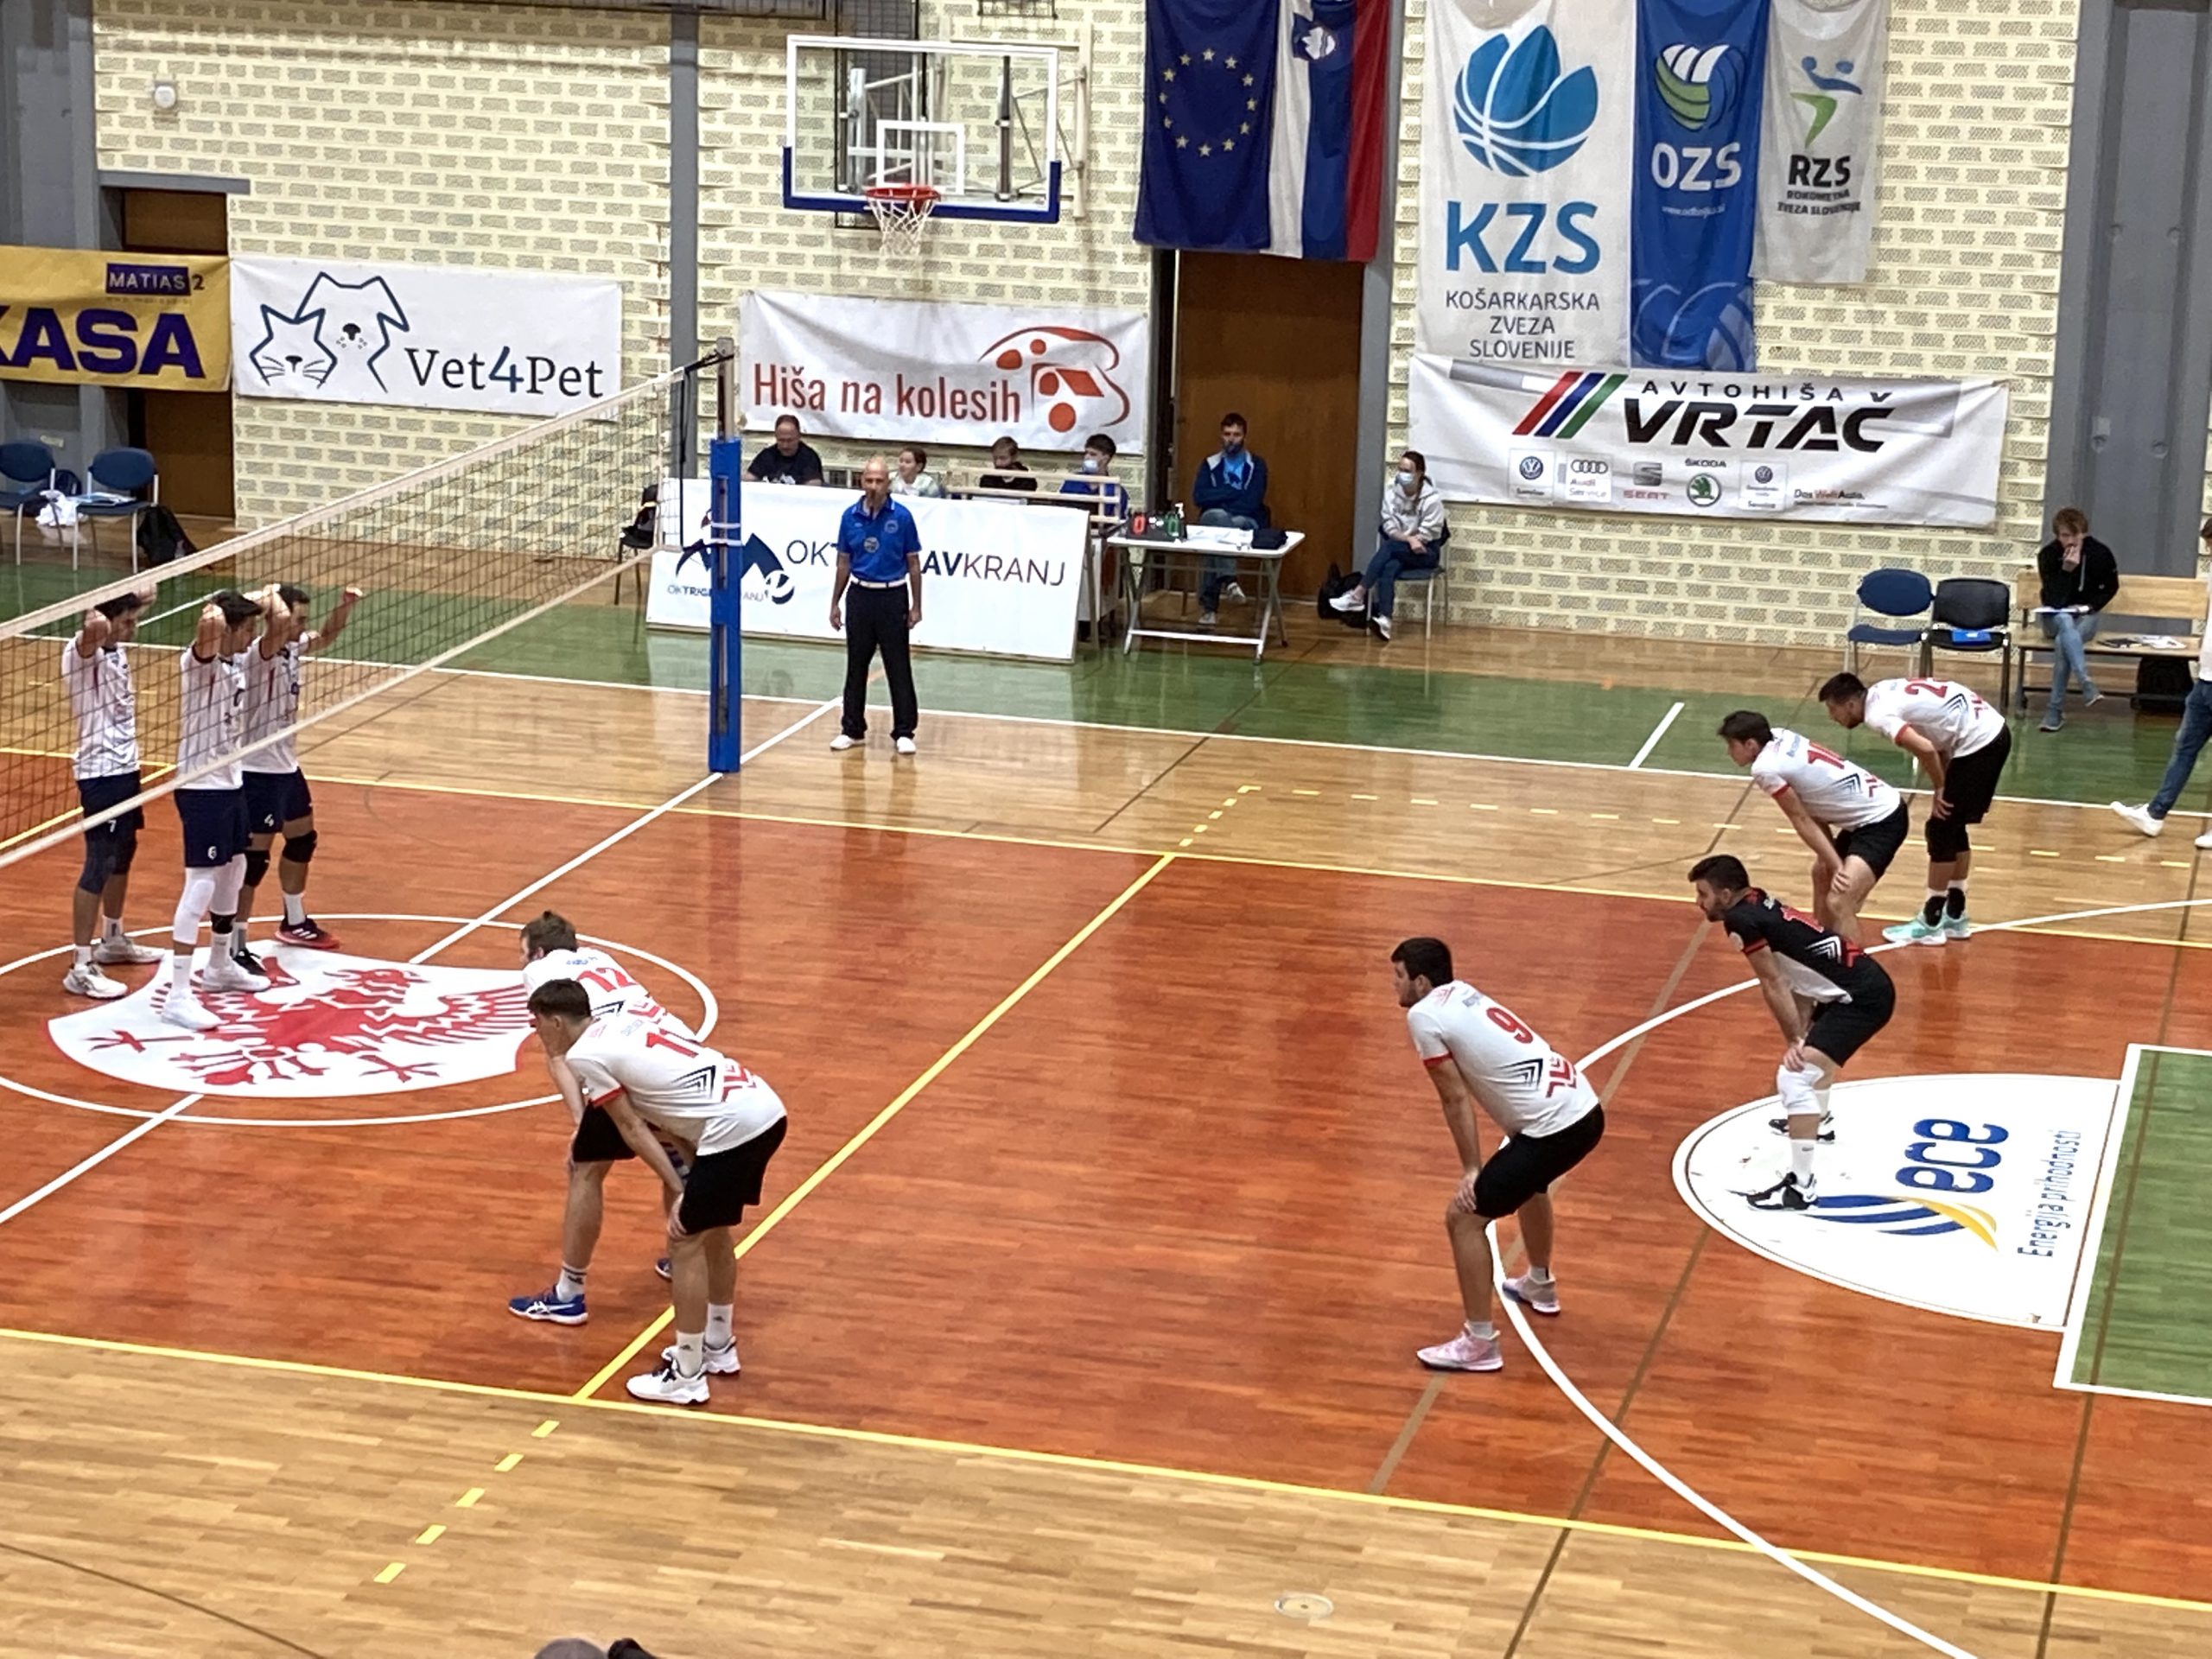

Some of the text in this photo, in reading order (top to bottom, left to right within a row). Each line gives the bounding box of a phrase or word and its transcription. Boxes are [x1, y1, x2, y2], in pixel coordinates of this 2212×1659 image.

[1651, 142, 1742, 191] OZS
[1788, 154, 1851, 188] RZS
[1446, 200, 1601, 275] KZS
[110, 273, 205, 290] MATIAS 2
[1446, 287, 1600, 311] KOŠARKARSKA
[1490, 315, 1555, 335] ZVEZA
[1469, 339, 1575, 359] SLOVENIJE
[404, 346, 603, 398] Vet4Pet
[754, 363, 1020, 423] Hiša na kolesih
[1642, 382, 1844, 401] AVTOHIŠA
[1624, 391, 1897, 453] VRTAČ
[1623, 490, 1669, 499] SEAT
[1485, 1007, 1534, 1045] 9
[2017, 1128, 2082, 1258] Energija prihodnosti
